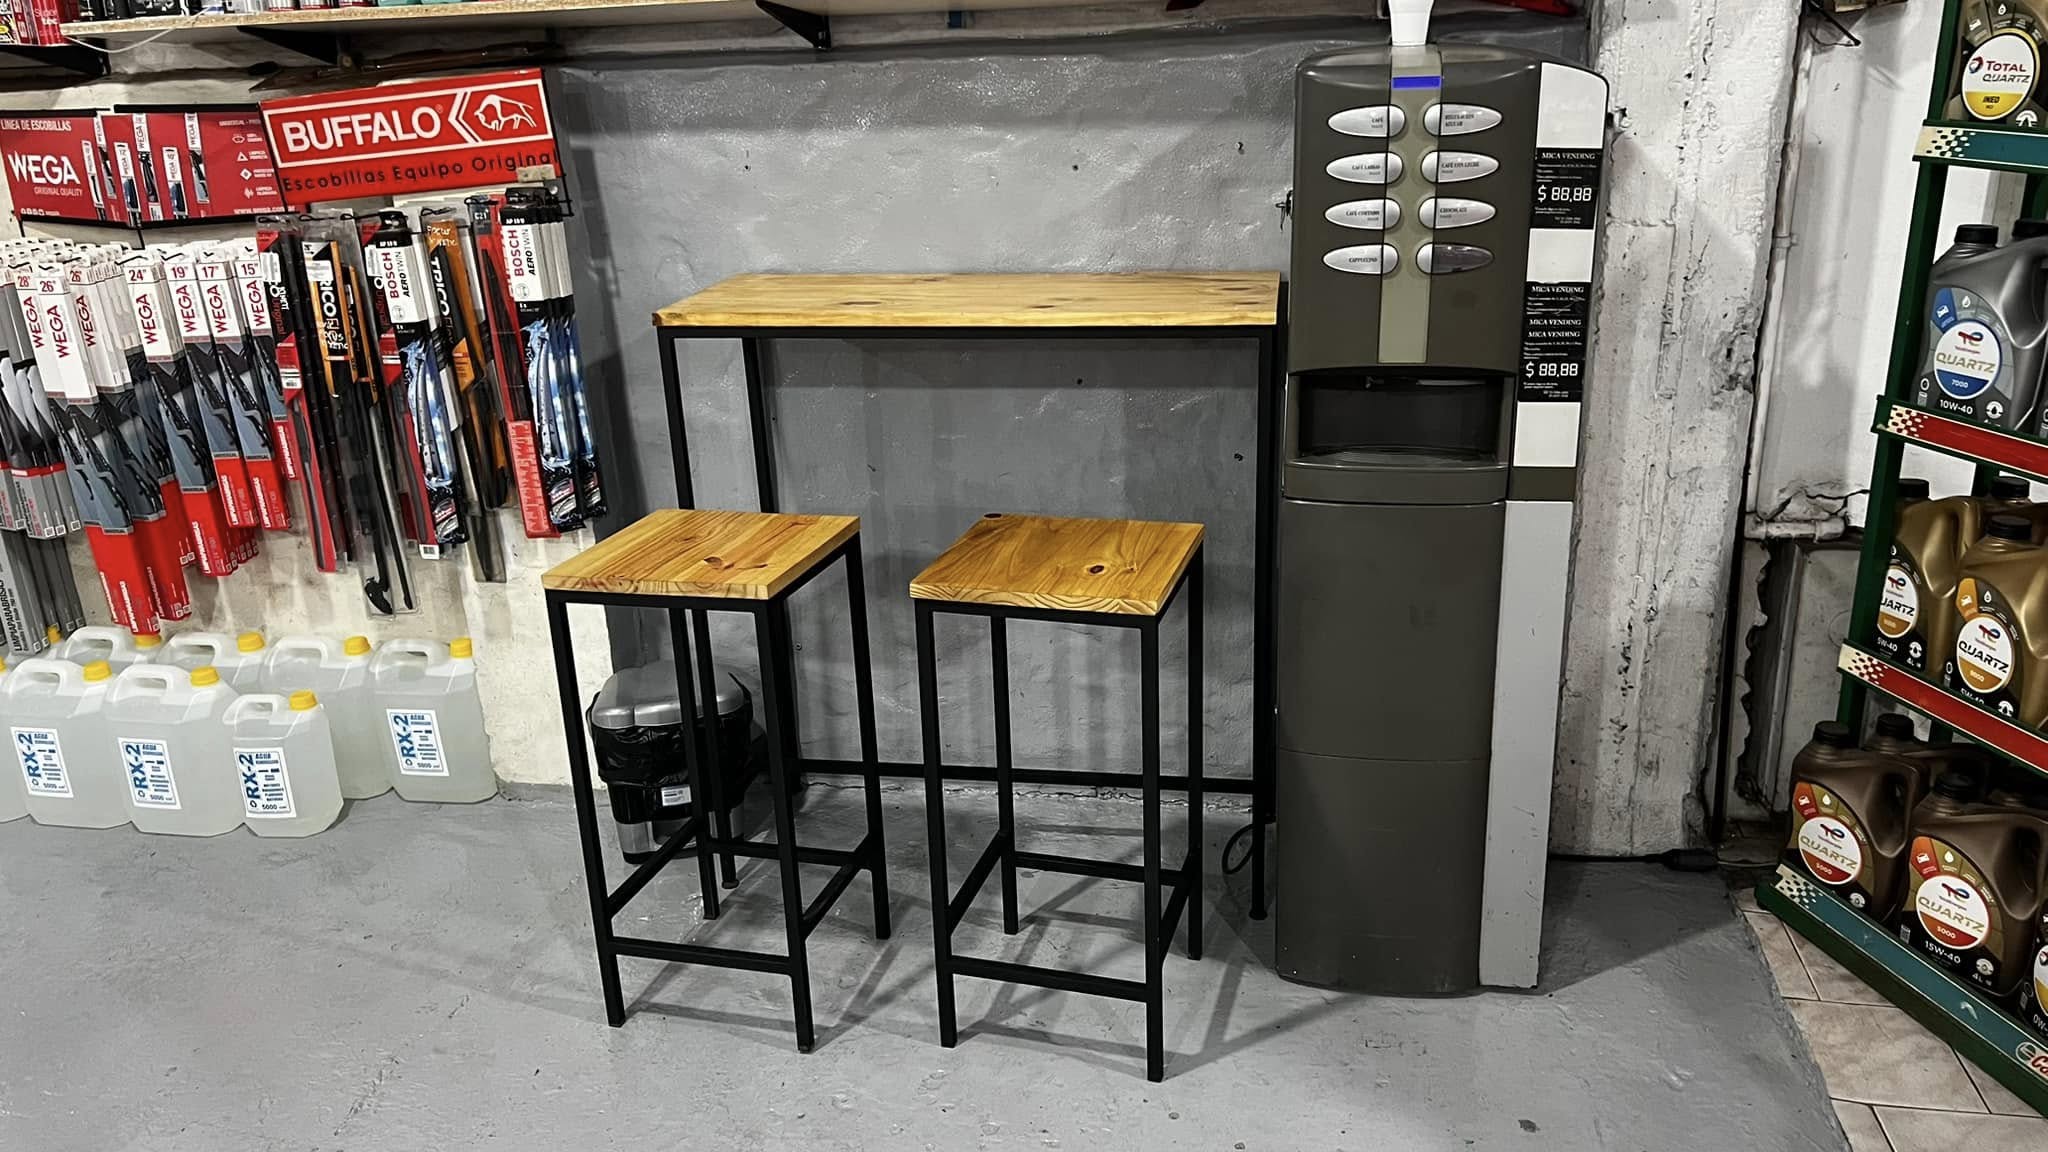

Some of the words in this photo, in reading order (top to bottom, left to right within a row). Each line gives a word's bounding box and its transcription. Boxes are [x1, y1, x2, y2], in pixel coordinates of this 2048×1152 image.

[1982, 73, 2031, 84] QUARTZ
[1985, 60, 2027, 73] TOTAL
[281, 105, 442, 153] BUFFALO
[8, 151, 80, 185] WEGA
[1562, 152, 1596, 160] VENDING
[282, 168, 386, 192] Escobillas
[392, 161, 464, 183] Equipo
[1537, 184, 1547, 203] $
[507, 229, 525, 277] BOSCH
[40, 280, 56, 292] 26"
[129, 268, 147, 281] 24"
[381, 251, 400, 299] BOSCH
[75, 294, 97, 347] WEGA
[136, 293, 159, 344] WEGA
[178, 284, 199, 333] WEGA
[207, 284, 229, 333] WEGA
[248, 279, 267, 327] WEGA
[23, 295, 45, 348] WEGA
[46, 304, 71, 359] WEGA
[1525, 361, 1535, 379] $
[1935, 352, 1996, 374] QUARTZ
[1951, 379, 1969, 389] 7000
[1939, 399, 1974, 415] 10W-40
[1880, 597, 1916, 617] UARTZ
[1958, 641, 2009, 674] QUARTZ
[393, 715, 416, 758] RX-2
[18, 733, 42, 778] RX-2
[125, 744, 149, 789] RX-2
[238, 754, 260, 800] RX-2
[1800, 835, 1858, 871] QUARTZ
[1917, 896, 1985, 933] QUARTZ
[1936, 924, 1956, 939] 5000
[1924, 940, 1961, 964] 15W-40
